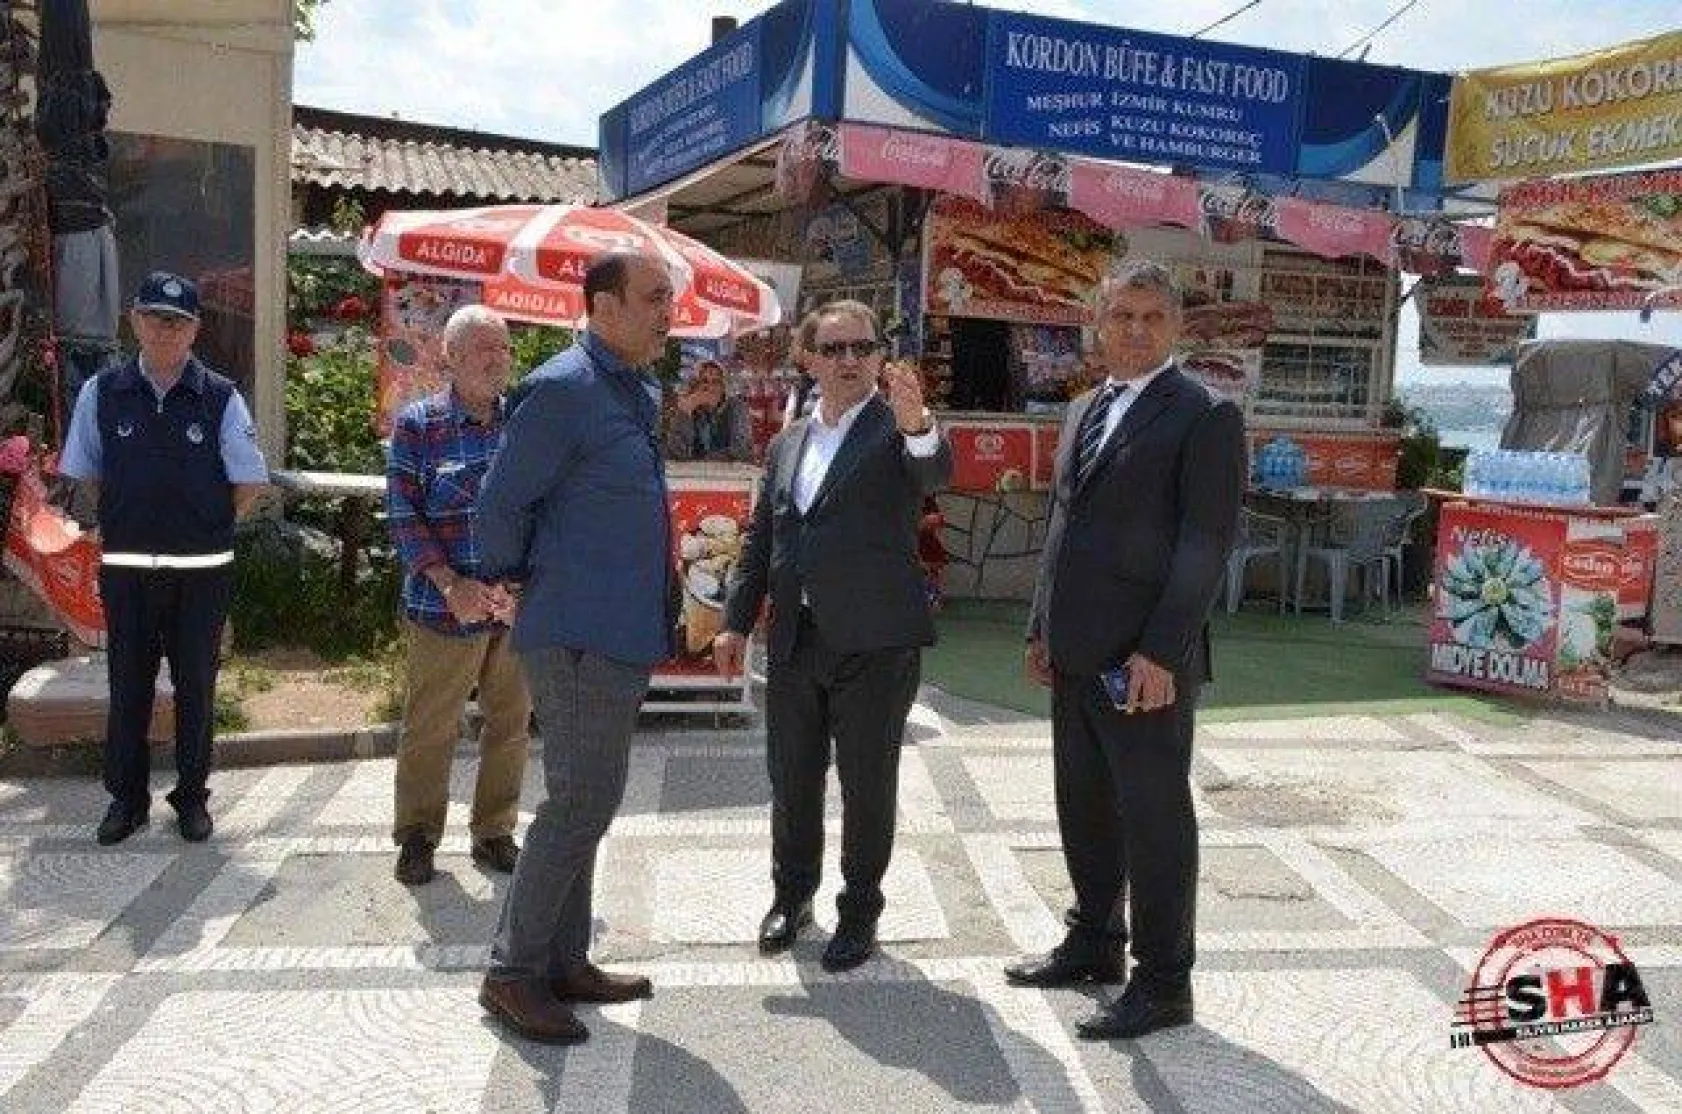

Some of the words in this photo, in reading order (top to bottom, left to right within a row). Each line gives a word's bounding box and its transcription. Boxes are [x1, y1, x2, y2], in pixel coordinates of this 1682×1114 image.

[1006, 30, 1100, 78] KORDON
[1161, 55, 1177, 88] &
[1181, 56, 1230, 95] FAST
[1232, 63, 1289, 104] FOOD
[1490, 127, 1578, 169] SUCUK
[416, 243, 487, 265] ALGIDA
